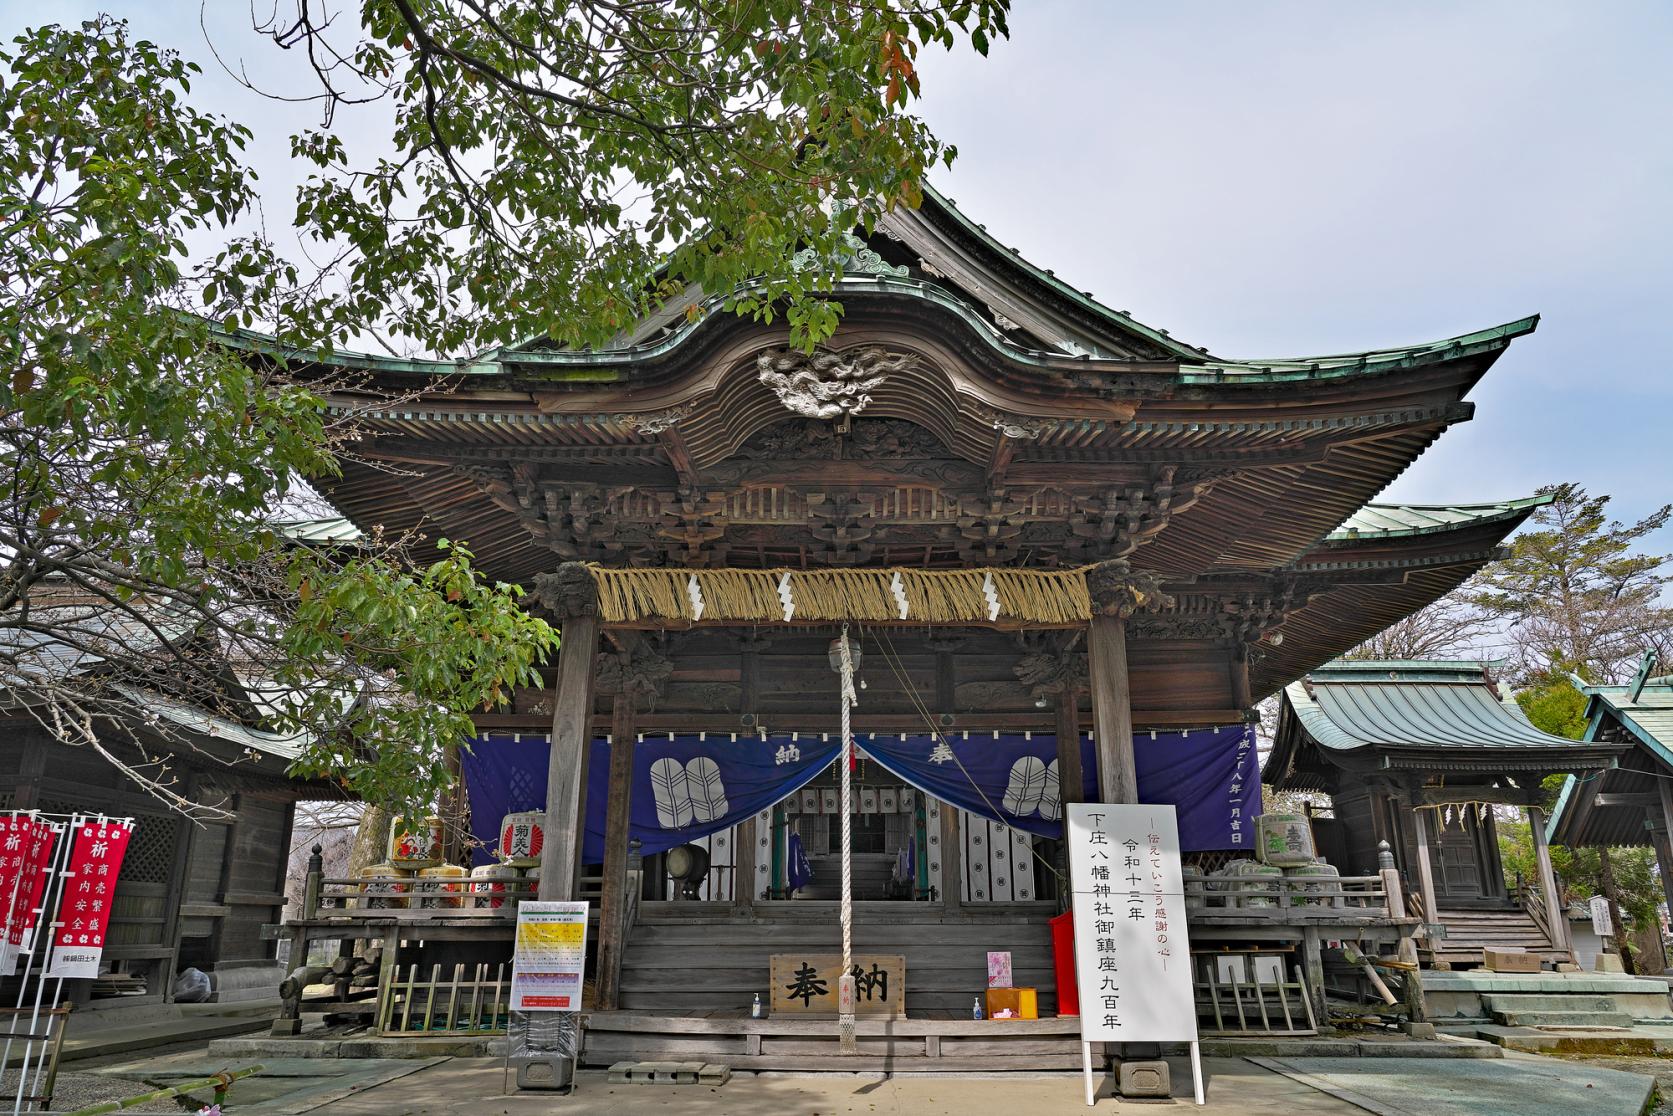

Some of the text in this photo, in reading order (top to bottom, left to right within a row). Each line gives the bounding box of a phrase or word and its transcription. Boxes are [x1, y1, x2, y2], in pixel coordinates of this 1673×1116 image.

[775, 744, 800, 765] 納
[928, 744, 953, 764] 奉
[4, 833, 21, 851] 祈
[90, 840, 109, 858] 祈
[512, 824, 529, 856] 菊美人
[72, 862, 95, 930] 家内安全
[88, 863, 109, 931] 商売繁盛
[1122, 838, 1145, 921] 令和十三年
[1088, 813, 1122, 1029] 下庄八幡神社御鎮座九百年
[786, 962, 888, 1007] 奉納
